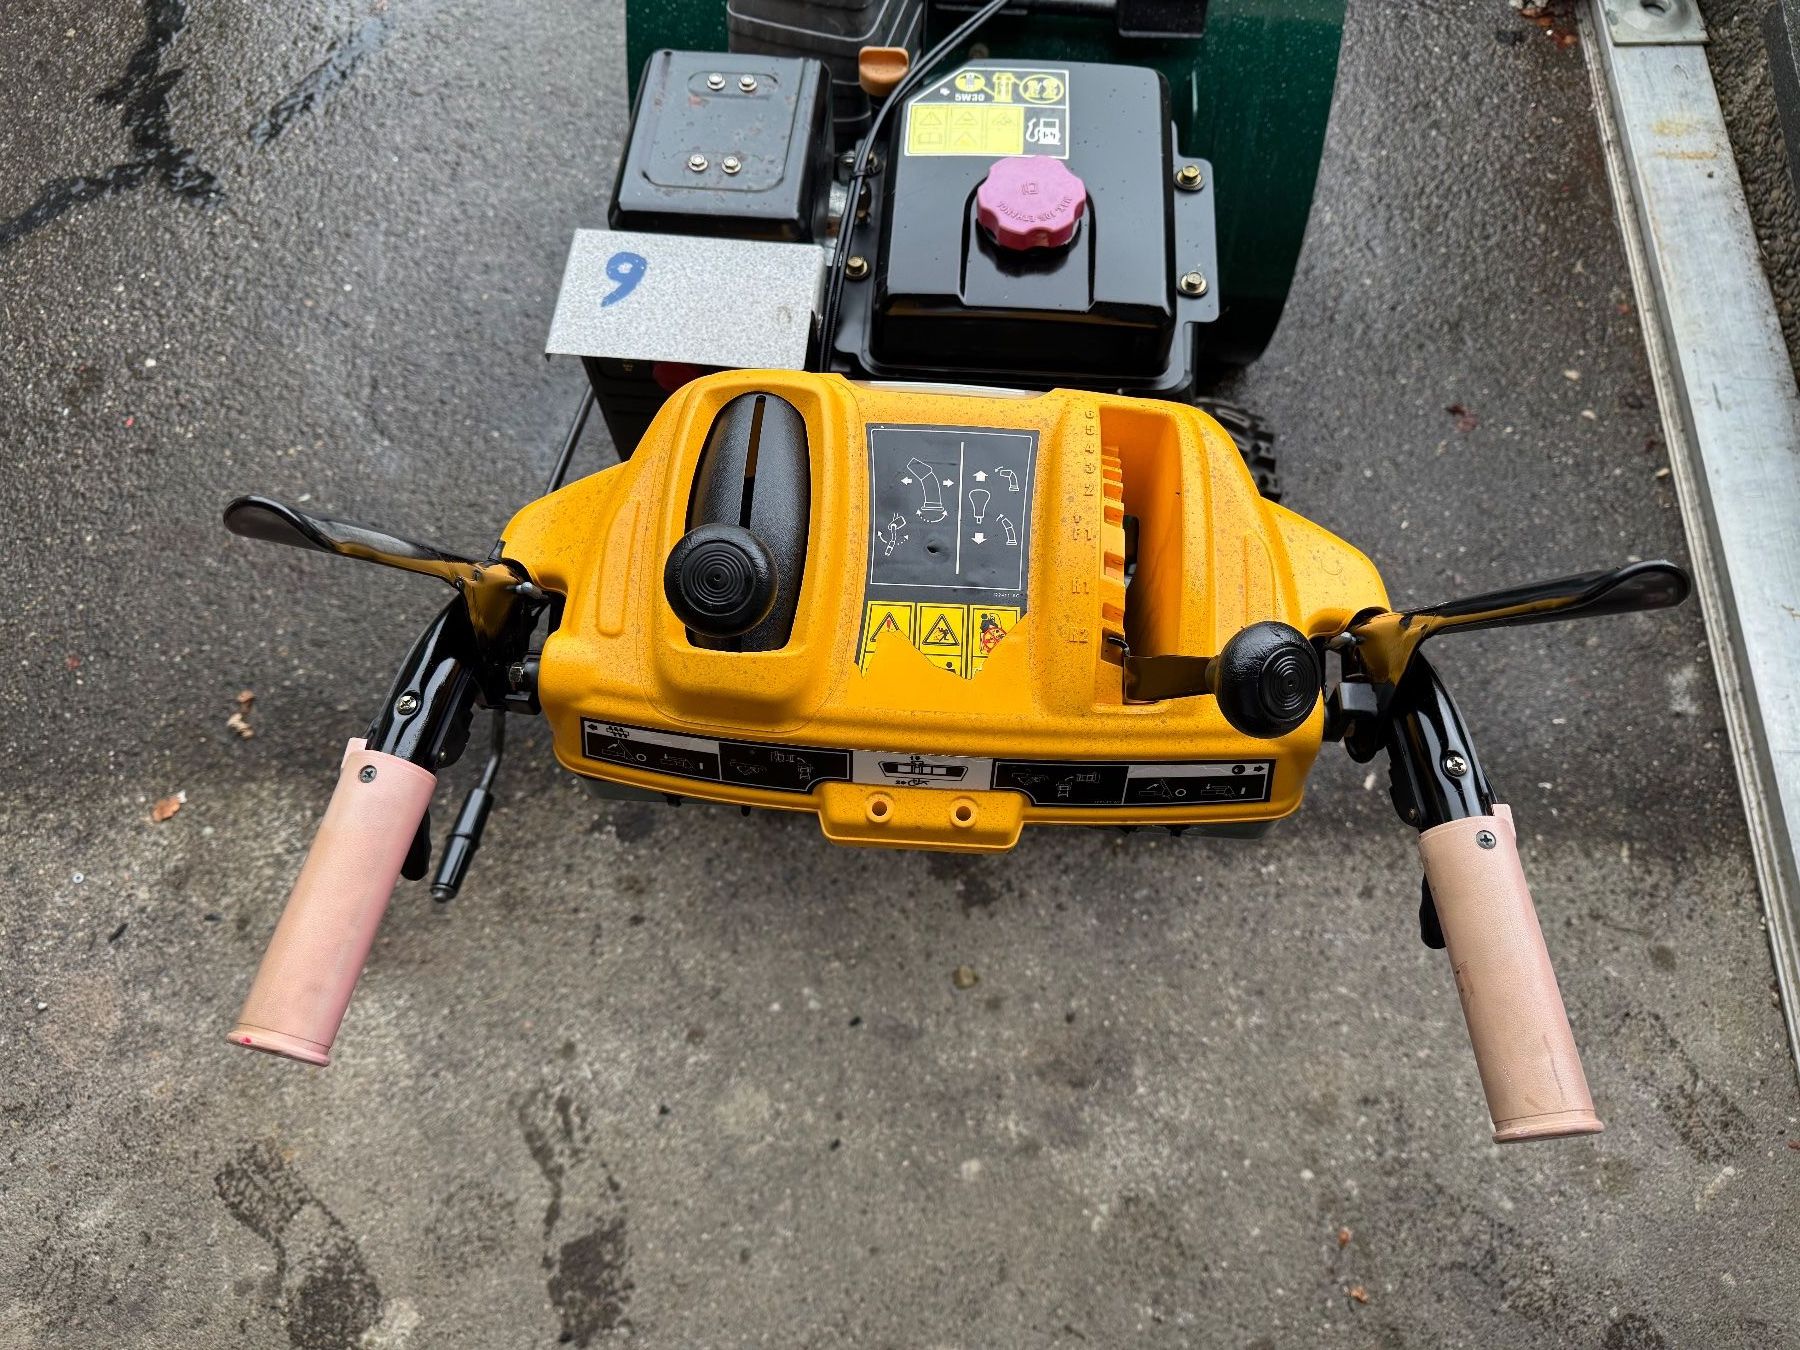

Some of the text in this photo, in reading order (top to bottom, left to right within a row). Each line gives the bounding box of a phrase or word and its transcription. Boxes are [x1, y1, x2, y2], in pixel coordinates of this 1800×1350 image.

[955, 93, 985, 102] 5W30
[601, 251, 648, 308] 9
[1085, 424, 1095, 436] 5
[1083, 483, 1095, 496] 2
